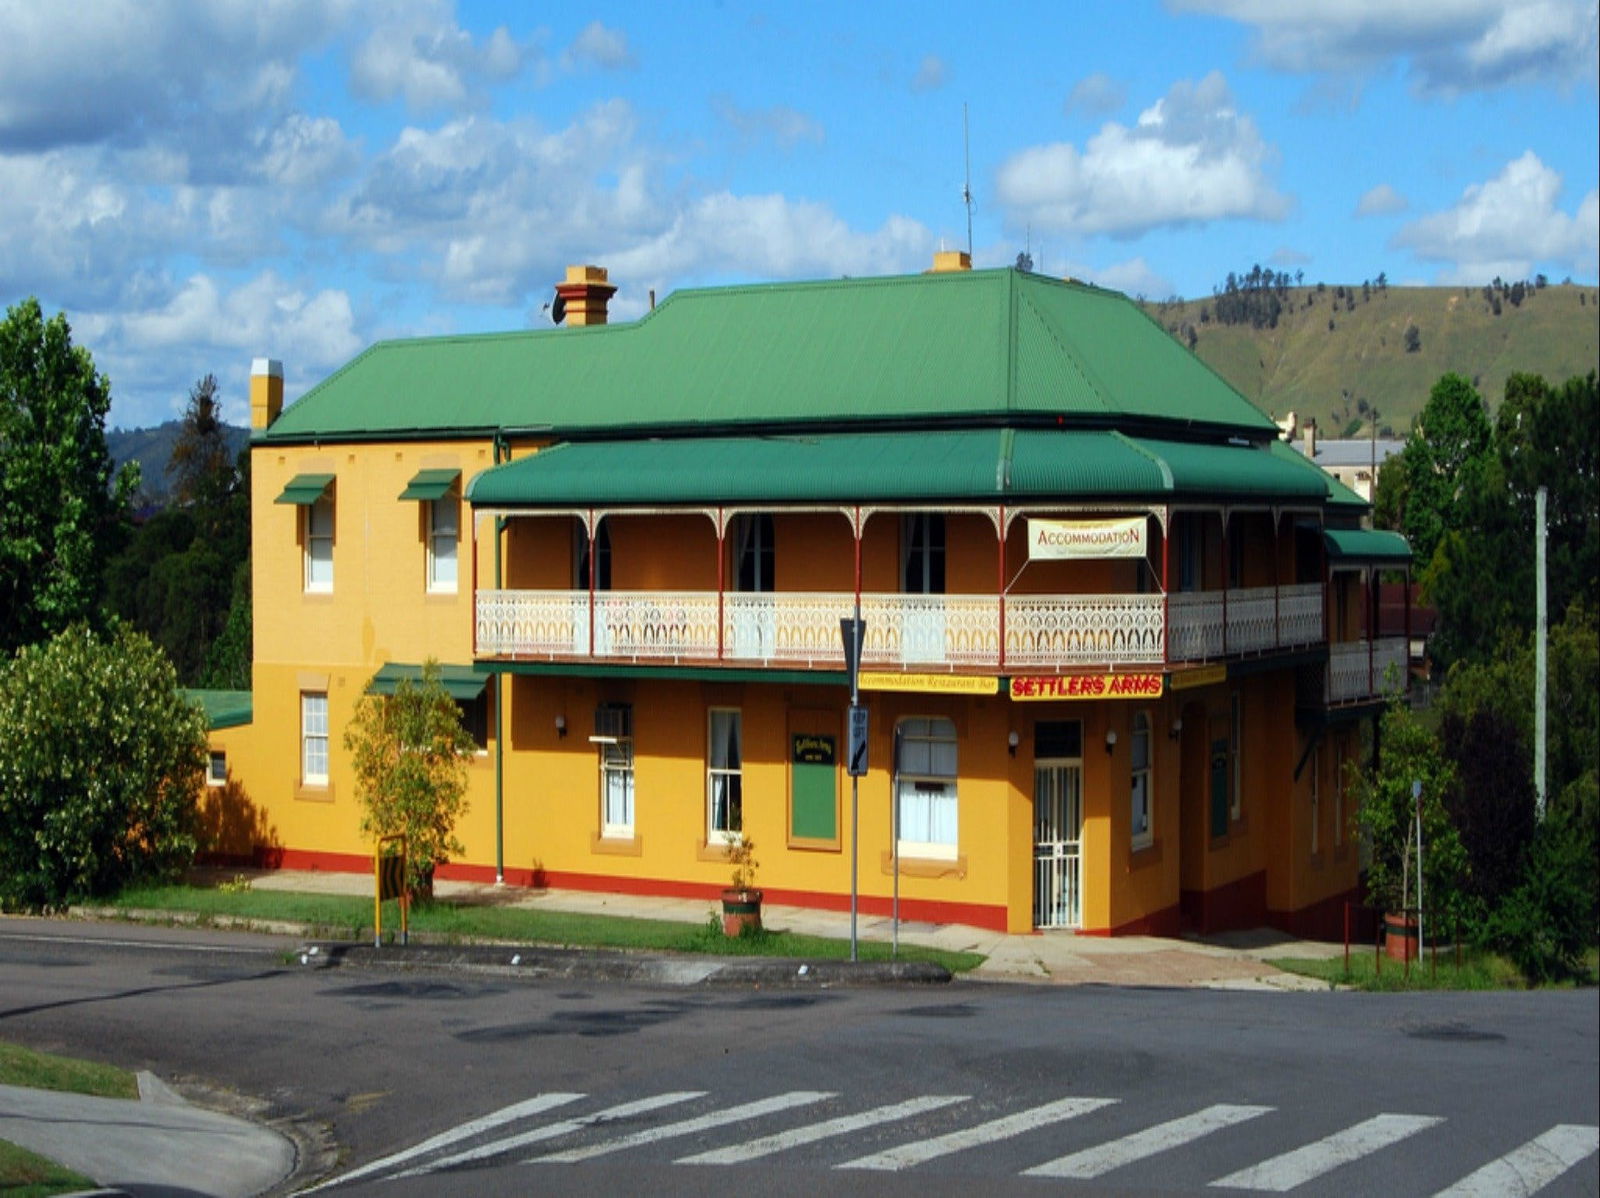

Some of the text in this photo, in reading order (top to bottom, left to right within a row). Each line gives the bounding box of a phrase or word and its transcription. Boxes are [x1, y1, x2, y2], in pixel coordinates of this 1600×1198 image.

[1038, 528, 1139, 545] ACCOMMODATION
[1012, 676, 1105, 697] SETTLERS
[1108, 674, 1162, 695] ARMS
